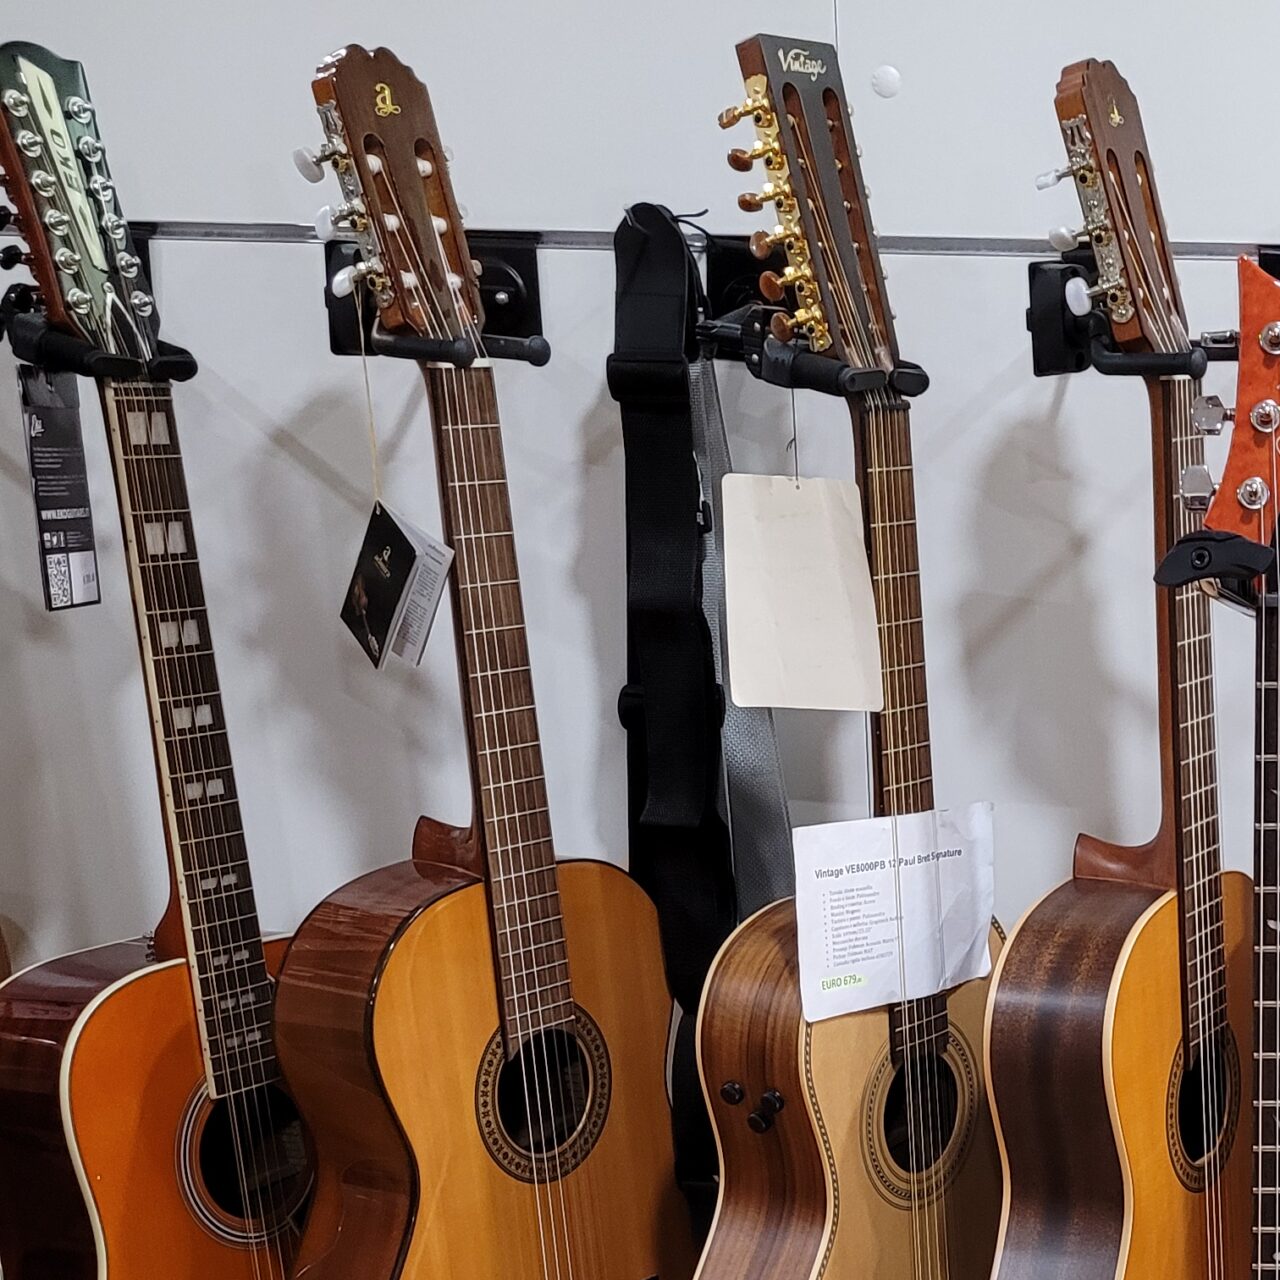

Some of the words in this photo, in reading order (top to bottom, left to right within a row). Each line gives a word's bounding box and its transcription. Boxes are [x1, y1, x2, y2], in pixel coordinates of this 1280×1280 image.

[777, 47, 827, 82] Vintage
[49, 127, 83, 196] EKO
[814, 867, 844, 880] Vintage
[898, 855, 916, 868] Paul
[821, 977, 842, 991] EURO
